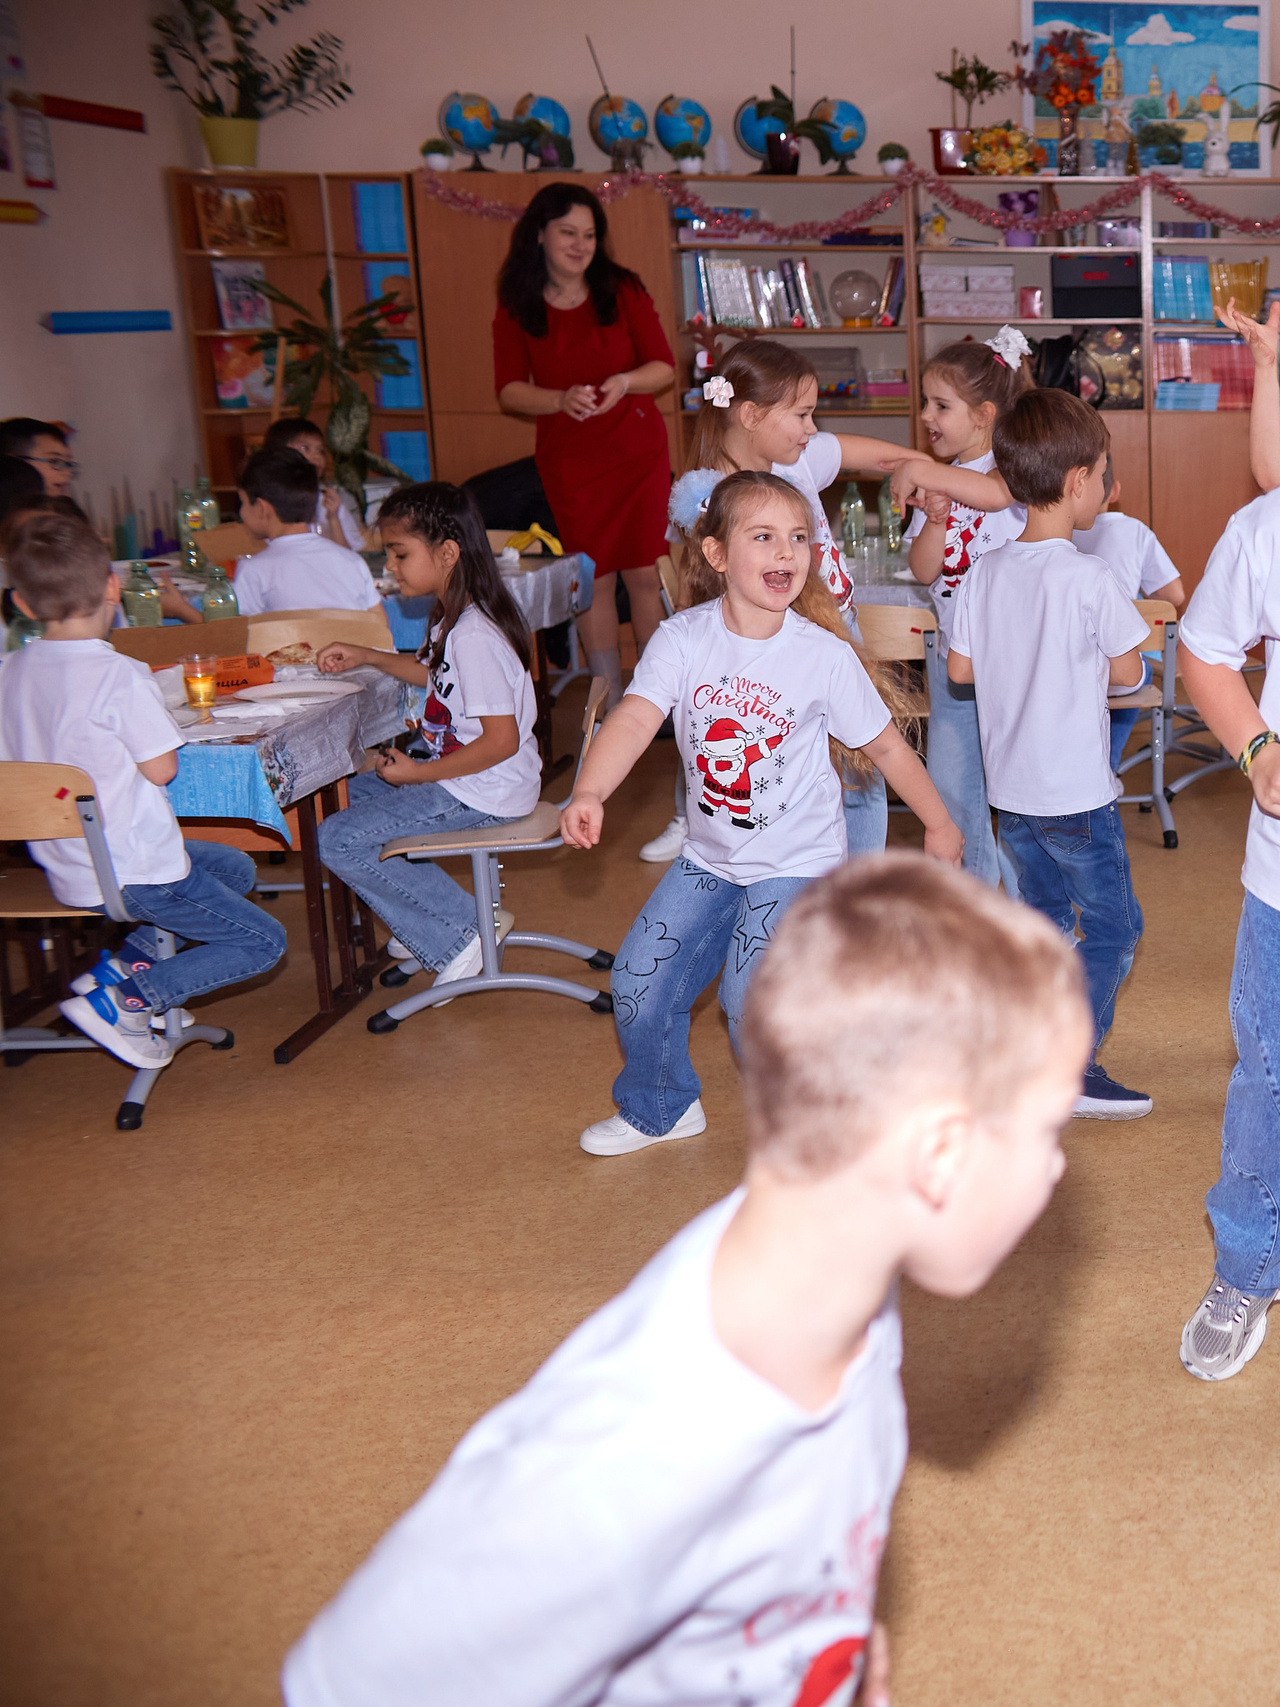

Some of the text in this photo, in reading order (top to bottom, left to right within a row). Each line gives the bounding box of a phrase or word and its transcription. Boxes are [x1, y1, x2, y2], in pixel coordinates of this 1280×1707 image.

[730, 676, 783, 705] Merry
[693, 684, 797, 737] Christmas
[694, 876, 719, 892] NO
